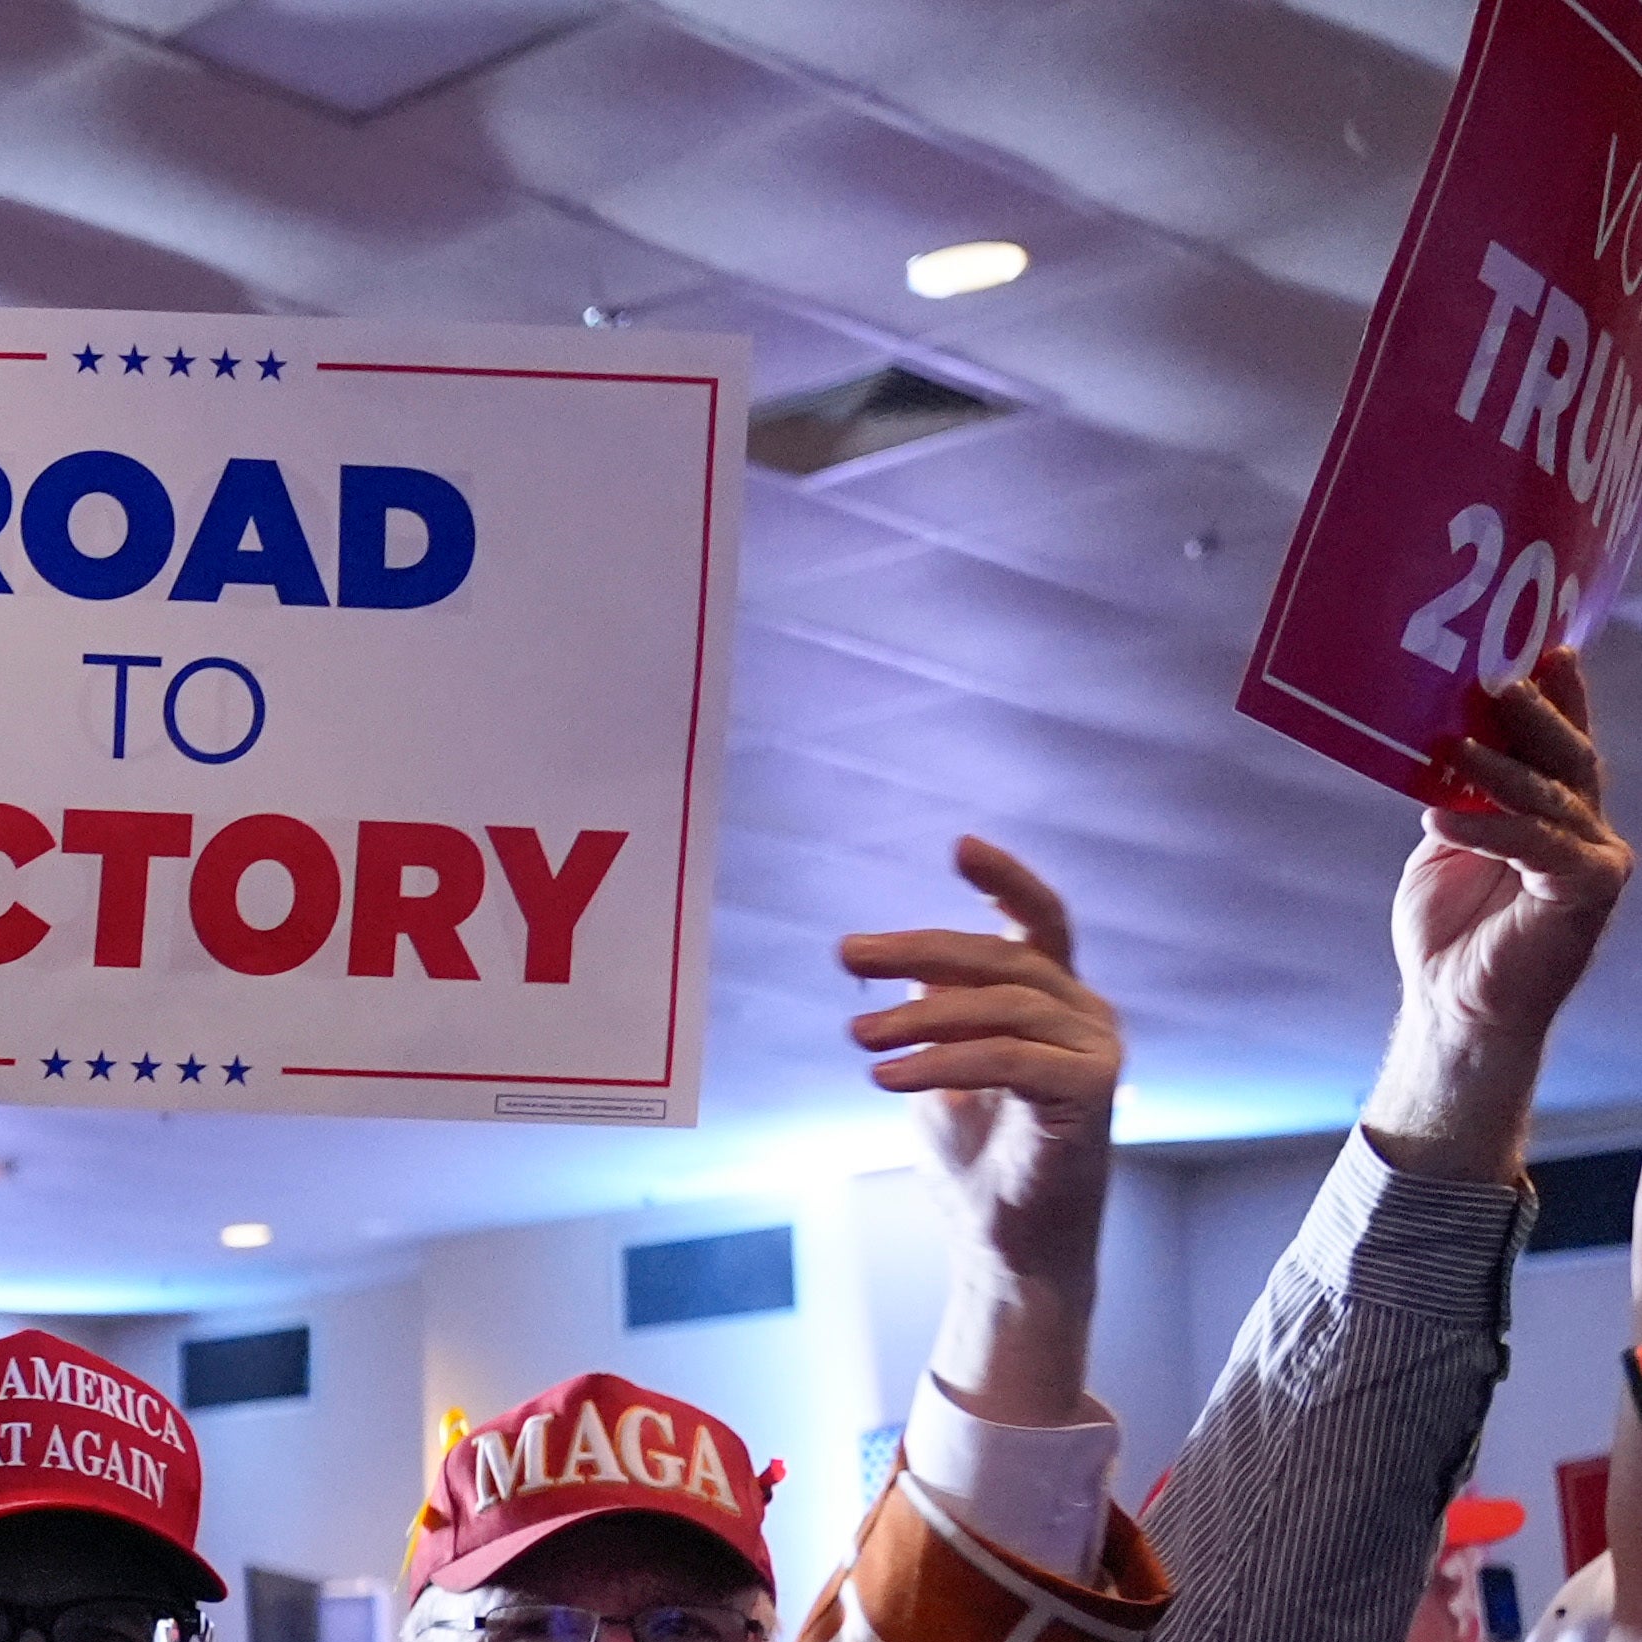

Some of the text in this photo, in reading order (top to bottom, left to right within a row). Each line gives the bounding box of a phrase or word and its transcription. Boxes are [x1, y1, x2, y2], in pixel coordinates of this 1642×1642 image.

[82, 653, 266, 764] TO
[40, 1424, 167, 1508] AGAIN
[471, 1399, 741, 1517] MAGA
